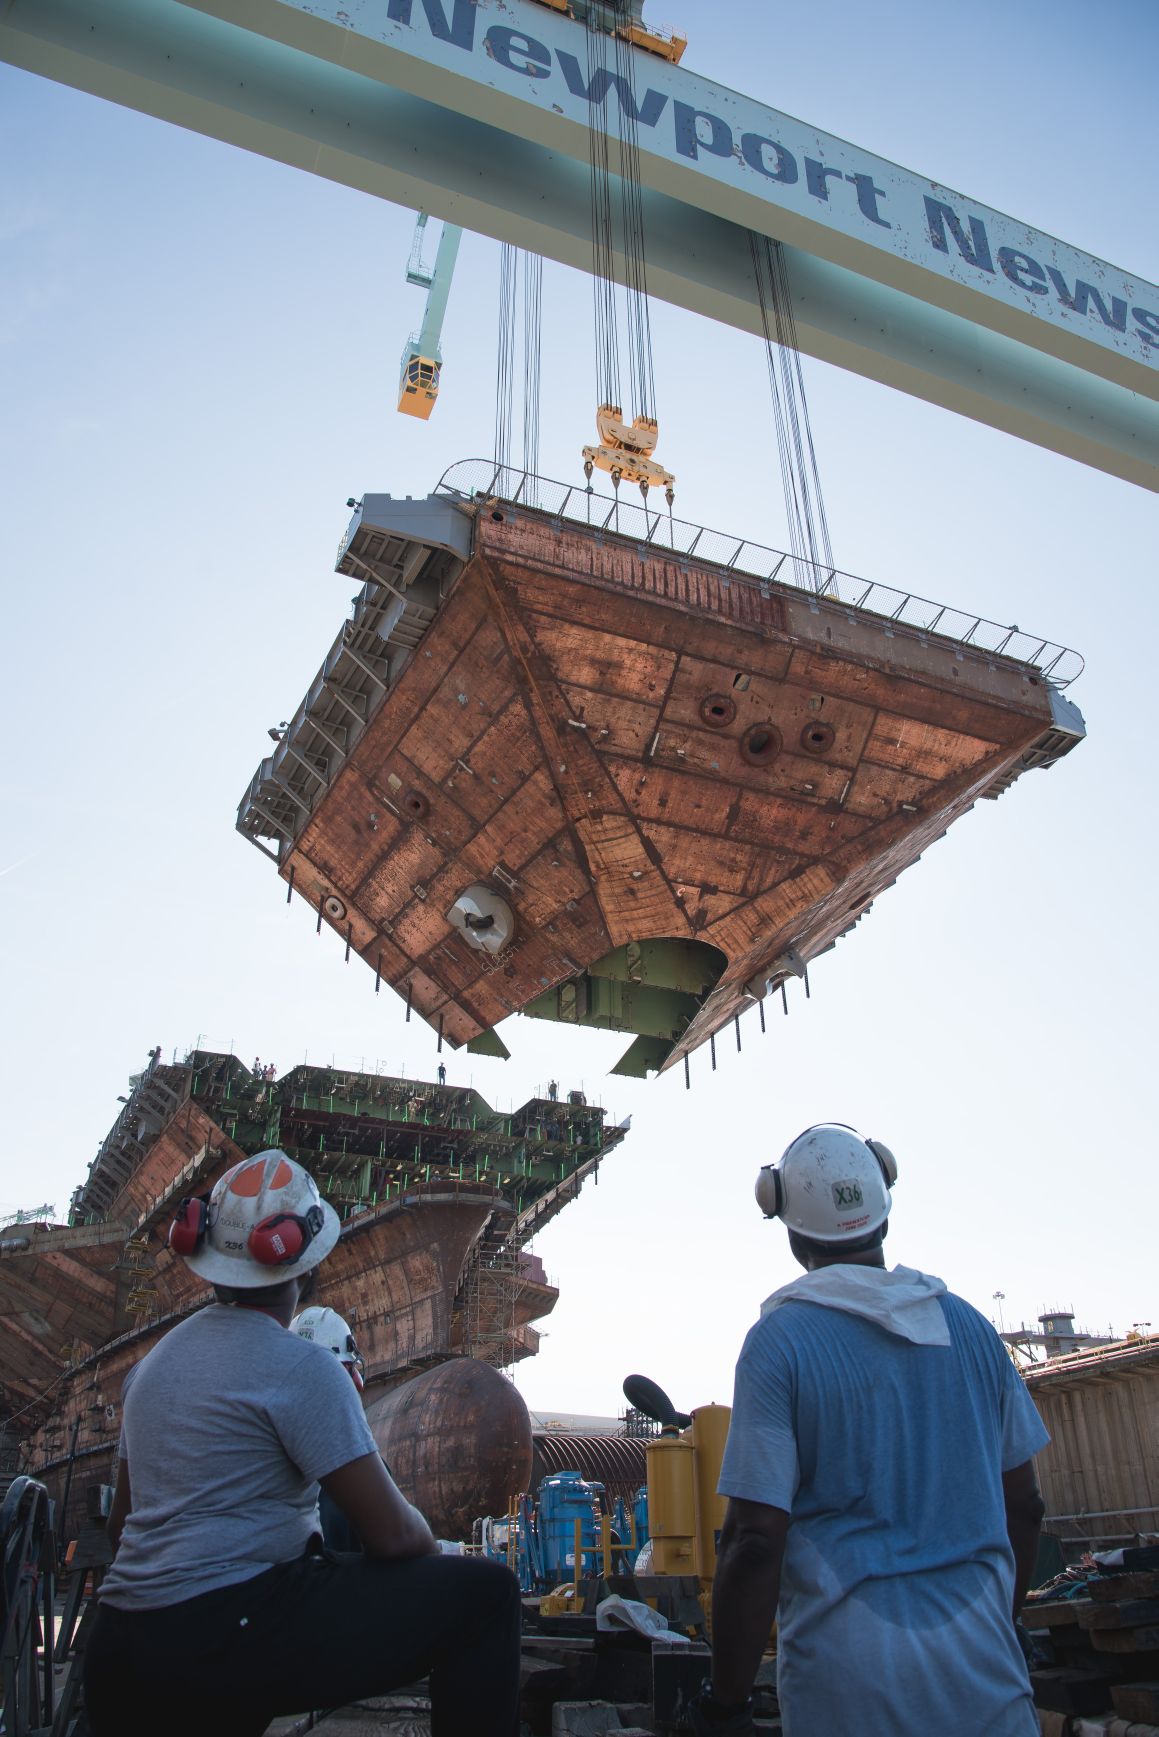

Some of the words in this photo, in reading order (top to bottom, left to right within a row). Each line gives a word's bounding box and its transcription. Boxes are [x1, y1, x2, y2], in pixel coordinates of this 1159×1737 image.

[386, 0, 892, 229] Newport
[922, 194, 1159, 350] News
[835, 1184, 860, 1205] X36
